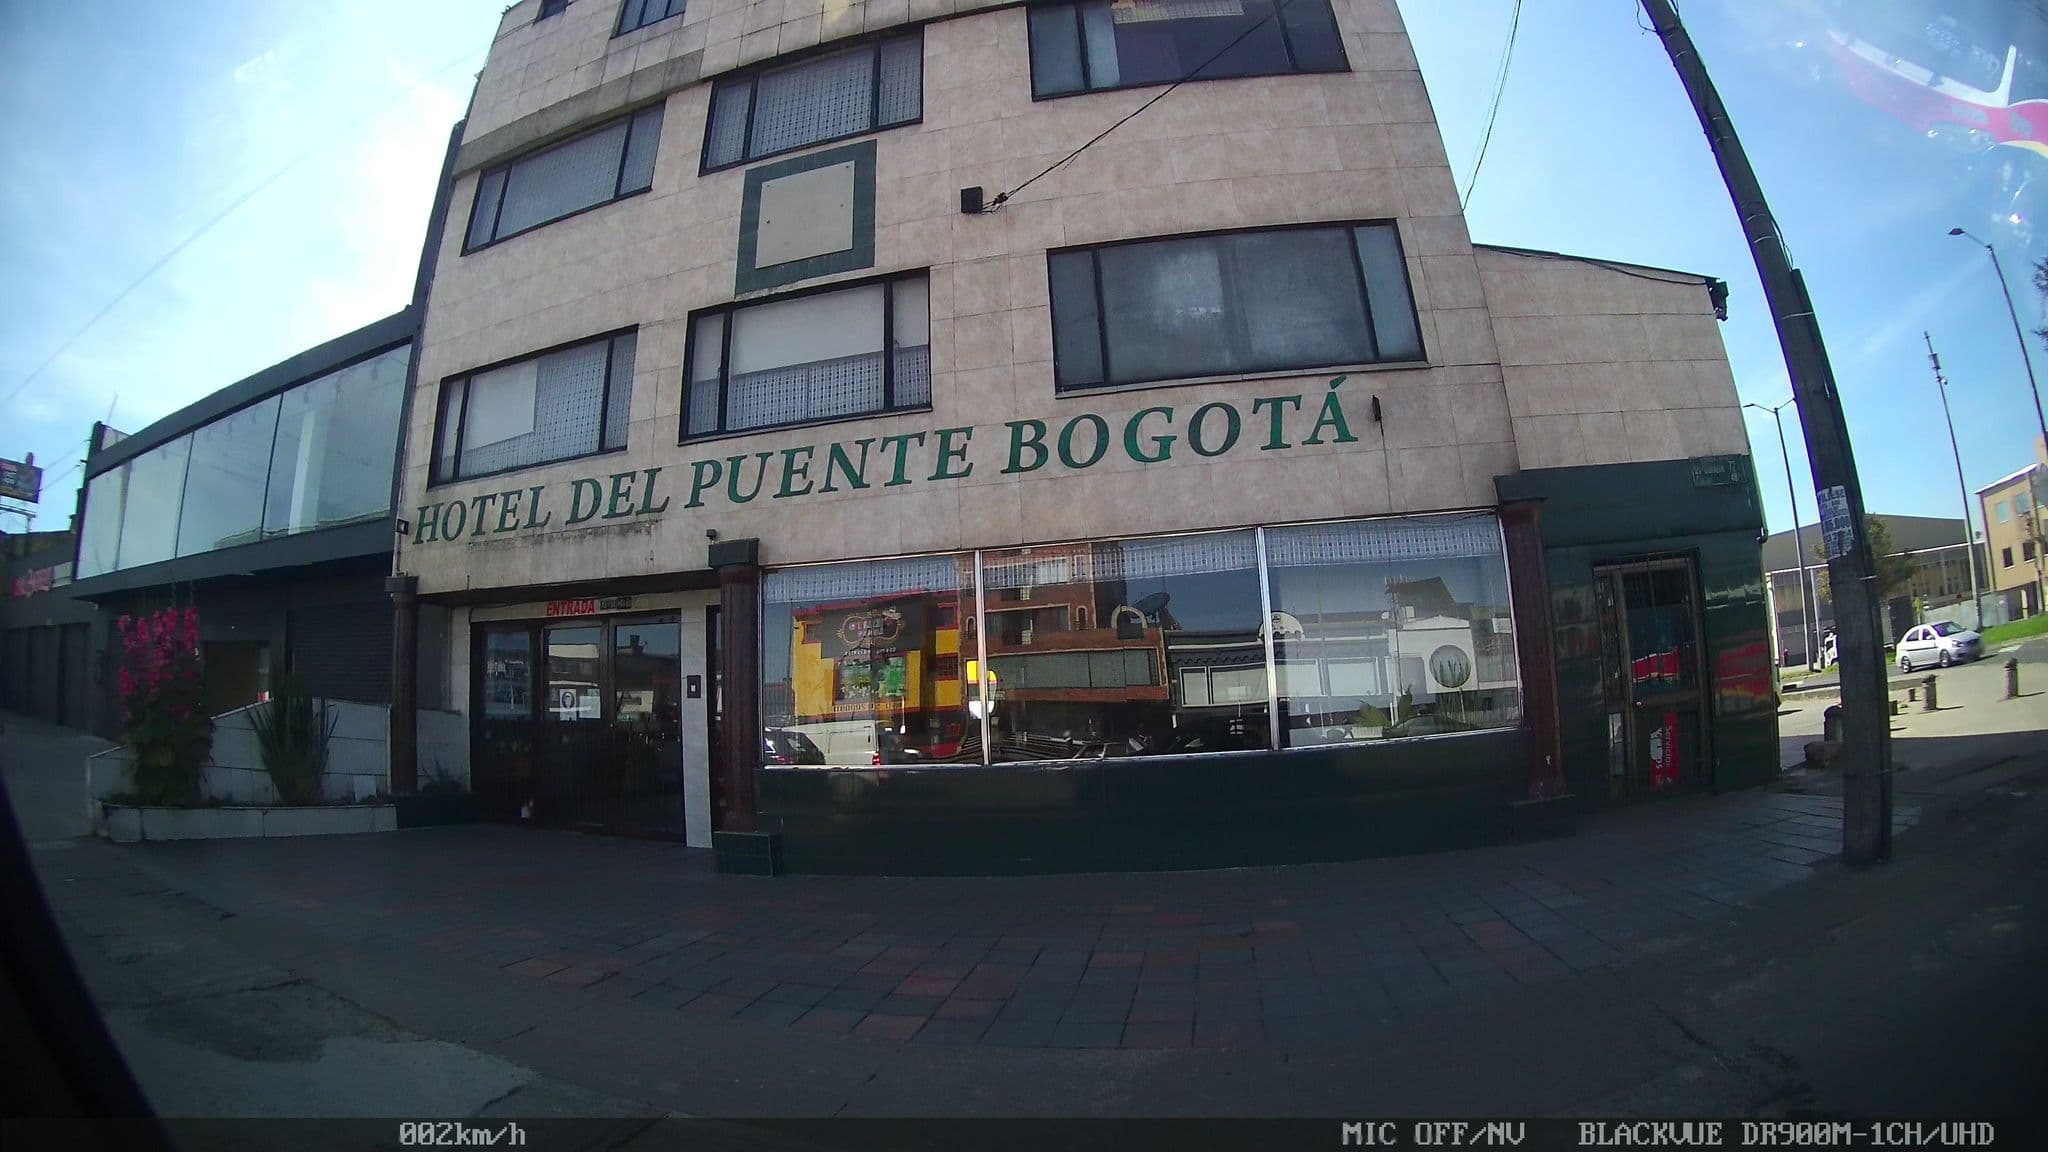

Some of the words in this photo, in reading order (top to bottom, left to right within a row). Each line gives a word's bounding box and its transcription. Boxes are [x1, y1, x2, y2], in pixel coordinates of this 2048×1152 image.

[413, 485, 551, 545] HOTEL
[565, 467, 670, 526] DEL
[683, 425, 974, 509] PUENTE
[1000, 374, 1359, 475] BOGOTÁ
[546, 599, 597, 617] ENTRADA
